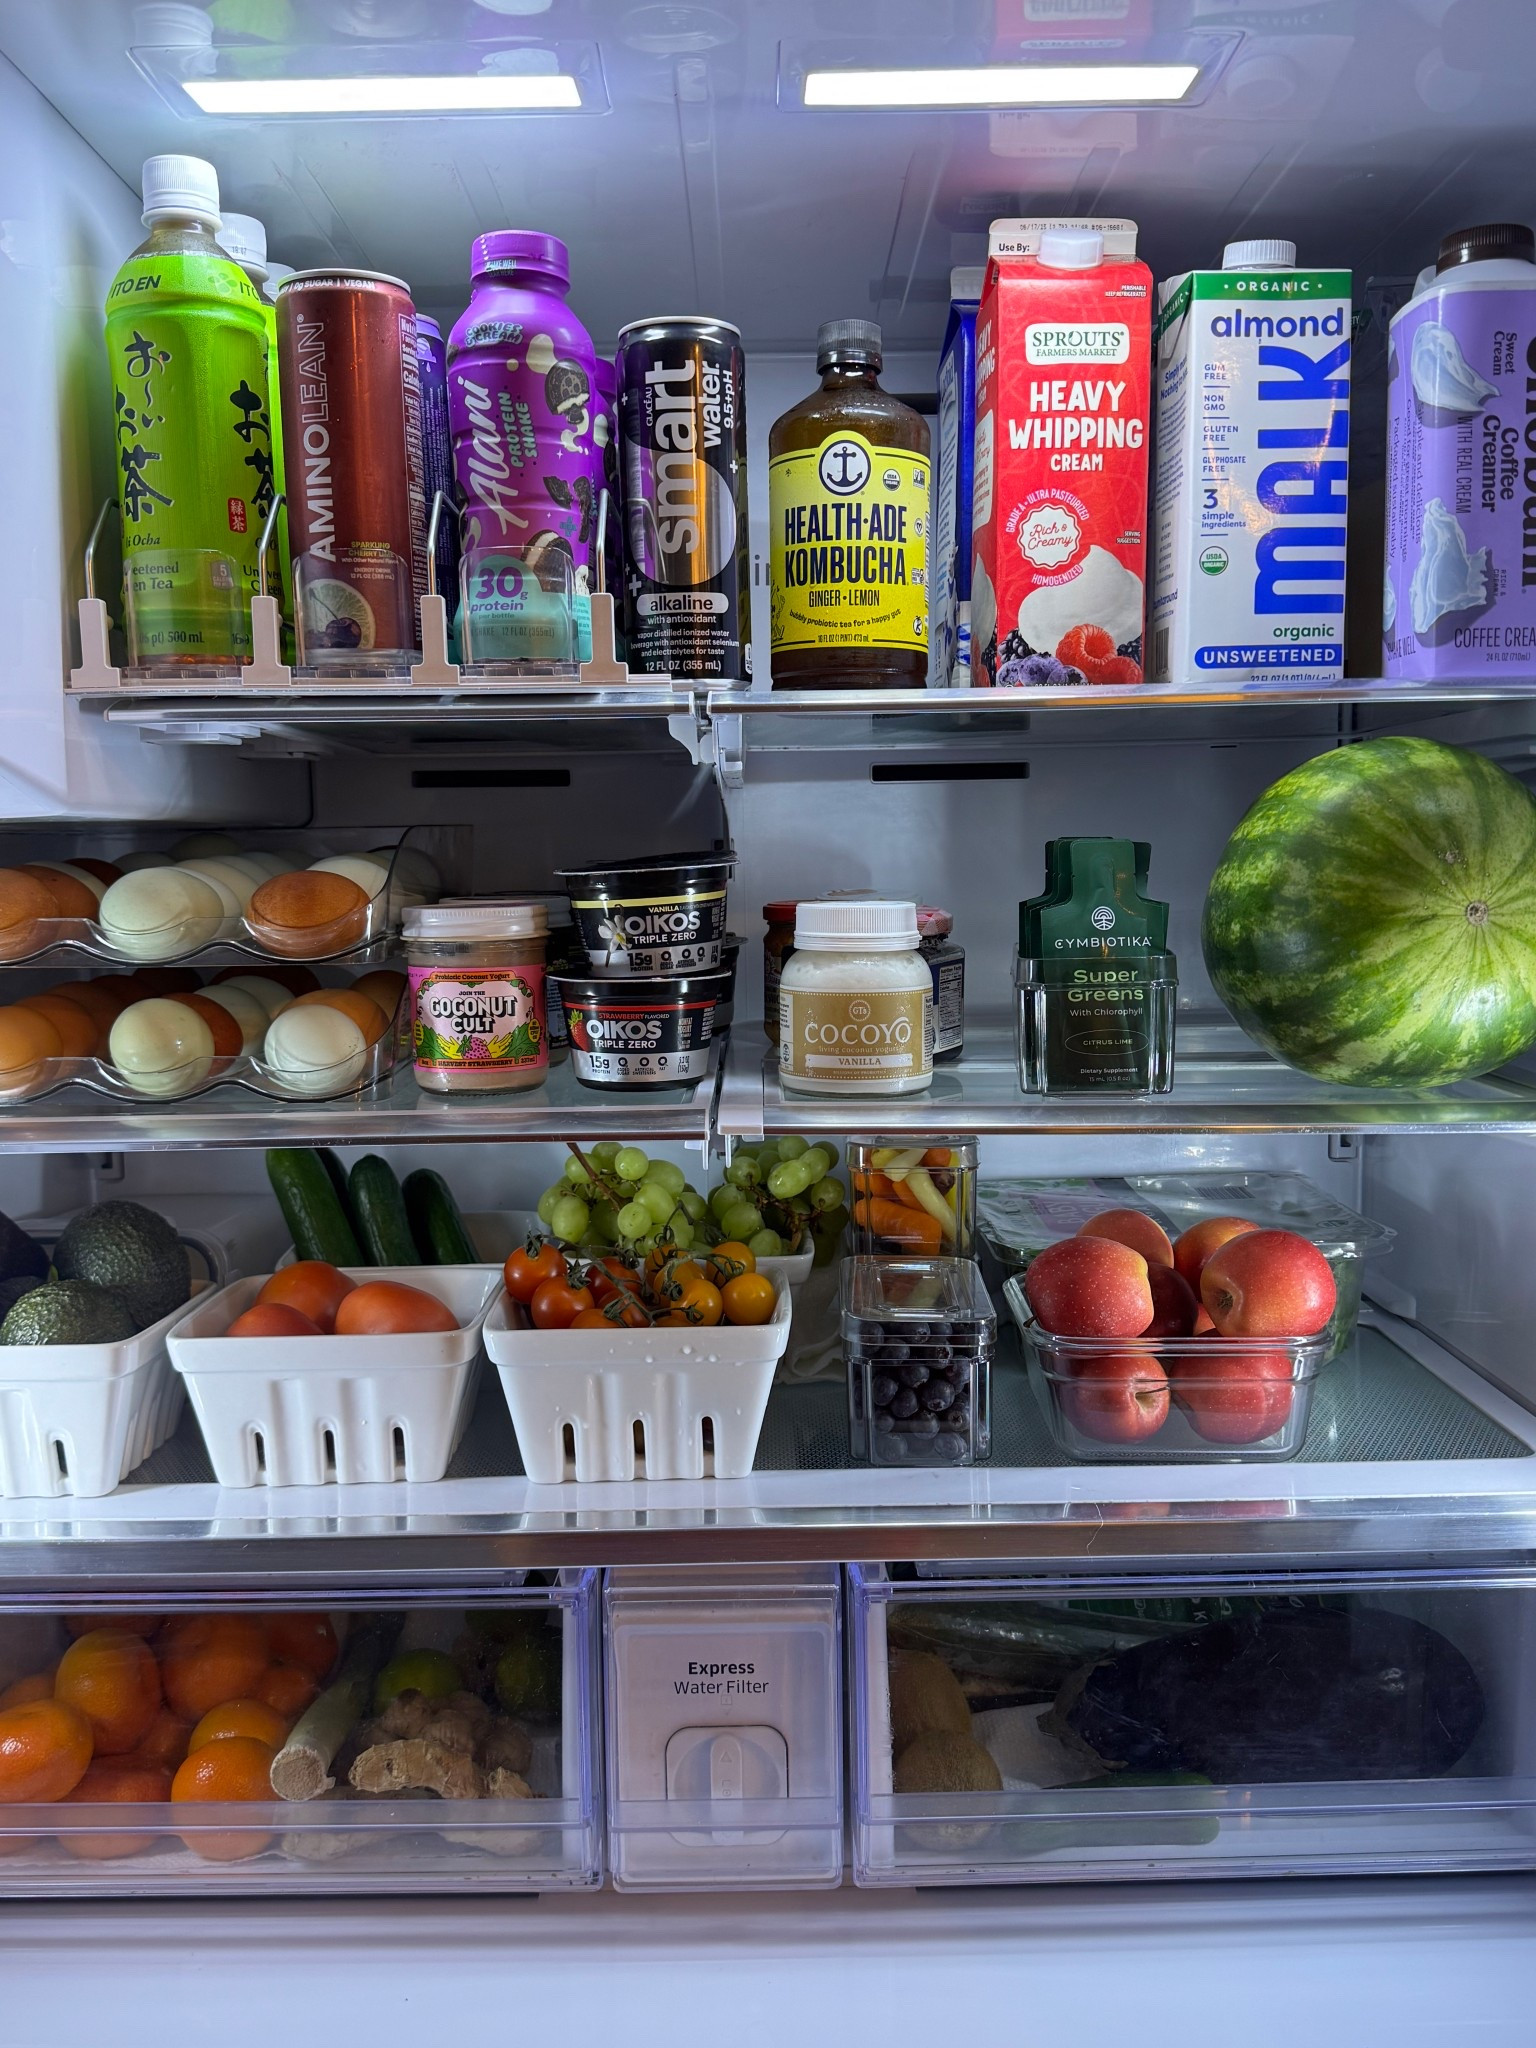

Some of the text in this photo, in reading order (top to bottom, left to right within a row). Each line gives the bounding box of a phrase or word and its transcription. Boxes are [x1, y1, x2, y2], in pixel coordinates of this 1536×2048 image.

[998, 243, 1030, 253] Use By:
[110, 274, 162, 300] ITO EN
[304, 278, 376, 290] SUGAR VEGAN
[1121, 284, 1147, 292] PERISHABLE
[1236, 280, 1310, 292] ORGANIC
[466, 322, 524, 337] COOKIES
[1210, 306, 1344, 338] almond
[475, 330, 523, 345] CREAM
[1032, 330, 1121, 347] SPROUTS
[1036, 348, 1117, 357] FARMERS MARKET
[1492, 330, 1506, 376] Cream
[1505, 332, 1518, 375] Sweet
[1204, 363, 1226, 372] GUM
[1204, 372, 1227, 380] FREE
[1029, 380, 1126, 413] HEAVY
[1204, 394, 1224, 402] NON
[1203, 403, 1226, 411] GMO
[497, 391, 525, 468] PROTEIN
[515, 402, 538, 458] SHAKE
[1008, 417, 1144, 450] WHIPPING
[1203, 425, 1239, 433] GLUTEN
[1203, 434, 1226, 442] FREE
[644, 359, 705, 555] smart
[1050, 453, 1104, 472] CREAM
[1202, 456, 1247, 464] GLYPHOSATE
[1481, 414, 1501, 513] Creamer
[1499, 427, 1520, 500] Coffee
[1202, 465, 1226, 473] FREE
[1415, 454, 1423, 478] and
[1455, 415, 1473, 515] WITH REAL CREAM
[1203, 488, 1219, 509] 3
[1005, 488, 1090, 533] GRADE A ULTRA PASTEURIZED
[1201, 511, 1235, 522] simple
[1414, 482, 1423, 544] delicious
[1029, 522, 1059, 539] Rich
[1201, 520, 1247, 530] ingredients
[132, 534, 161, 547] Ocha
[351, 541, 391, 550] SPARKLING
[1027, 535, 1074, 550] Creamy
[219, 564, 228, 577] 5
[785, 546, 907, 588] KOMBUCHA
[1031, 564, 1084, 587] HOMOGENIZED
[151, 577, 174, 590] Tea
[650, 594, 714, 612] alkaline
[808, 589, 880, 608] GINGER LEMON
[470, 600, 524, 615] protein
[647, 614, 717, 625] with antioxidant
[807, 617, 838, 628] probiotic
[839, 620, 853, 628] tea
[853, 619, 866, 627] for
[871, 613, 891, 625] happy
[890, 608, 902, 619] gut
[167, 631, 187, 644] 500
[654, 629, 682, 638] distilled
[683, 628, 710, 637] ionized
[711, 630, 730, 638] water
[1273, 623, 1335, 642] organic
[1454, 627, 1501, 648] COFFEE
[654, 639, 669, 647] with
[670, 638, 711, 647] antioxidant
[712, 638, 739, 648] selenium
[641, 647, 725, 657] and electrolytes for taste
[1203, 648, 1336, 664] UNSWEETENED
[1486, 653, 1494, 662] 24
[645, 660, 722, 672] 12 FL OZ (355 mL)
[648, 905, 680, 914] VANILLA
[624, 911, 701, 935] OIKOS
[633, 931, 697, 945] TRIPLE ZERO
[1054, 936, 1152, 949] CYMBIOTIKA
[627, 952, 653, 967] 15g
[489, 973, 510, 981] Yogurt
[1073, 969, 1139, 986] Super
[1067, 988, 1144, 1003] Greens
[430, 995, 518, 1018] COCONUT
[1069, 1007, 1143, 1017] With Chlorophyll
[598, 1012, 645, 1020] STRAWBERRY
[451, 1016, 496, 1034] CULT
[586, 1019, 662, 1040] OIKOS
[804, 1016, 912, 1045] COCOYO
[592, 1039, 657, 1049] TRIPLE ZERO
[818, 1046, 840, 1054] living
[467, 1059, 513, 1068] STRAWBERRY
[589, 1054, 610, 1069] 15g
[838, 1058, 882, 1066] VANILLA
[687, 1661, 756, 1676] Express
[674, 1679, 769, 1695] Water Filter
